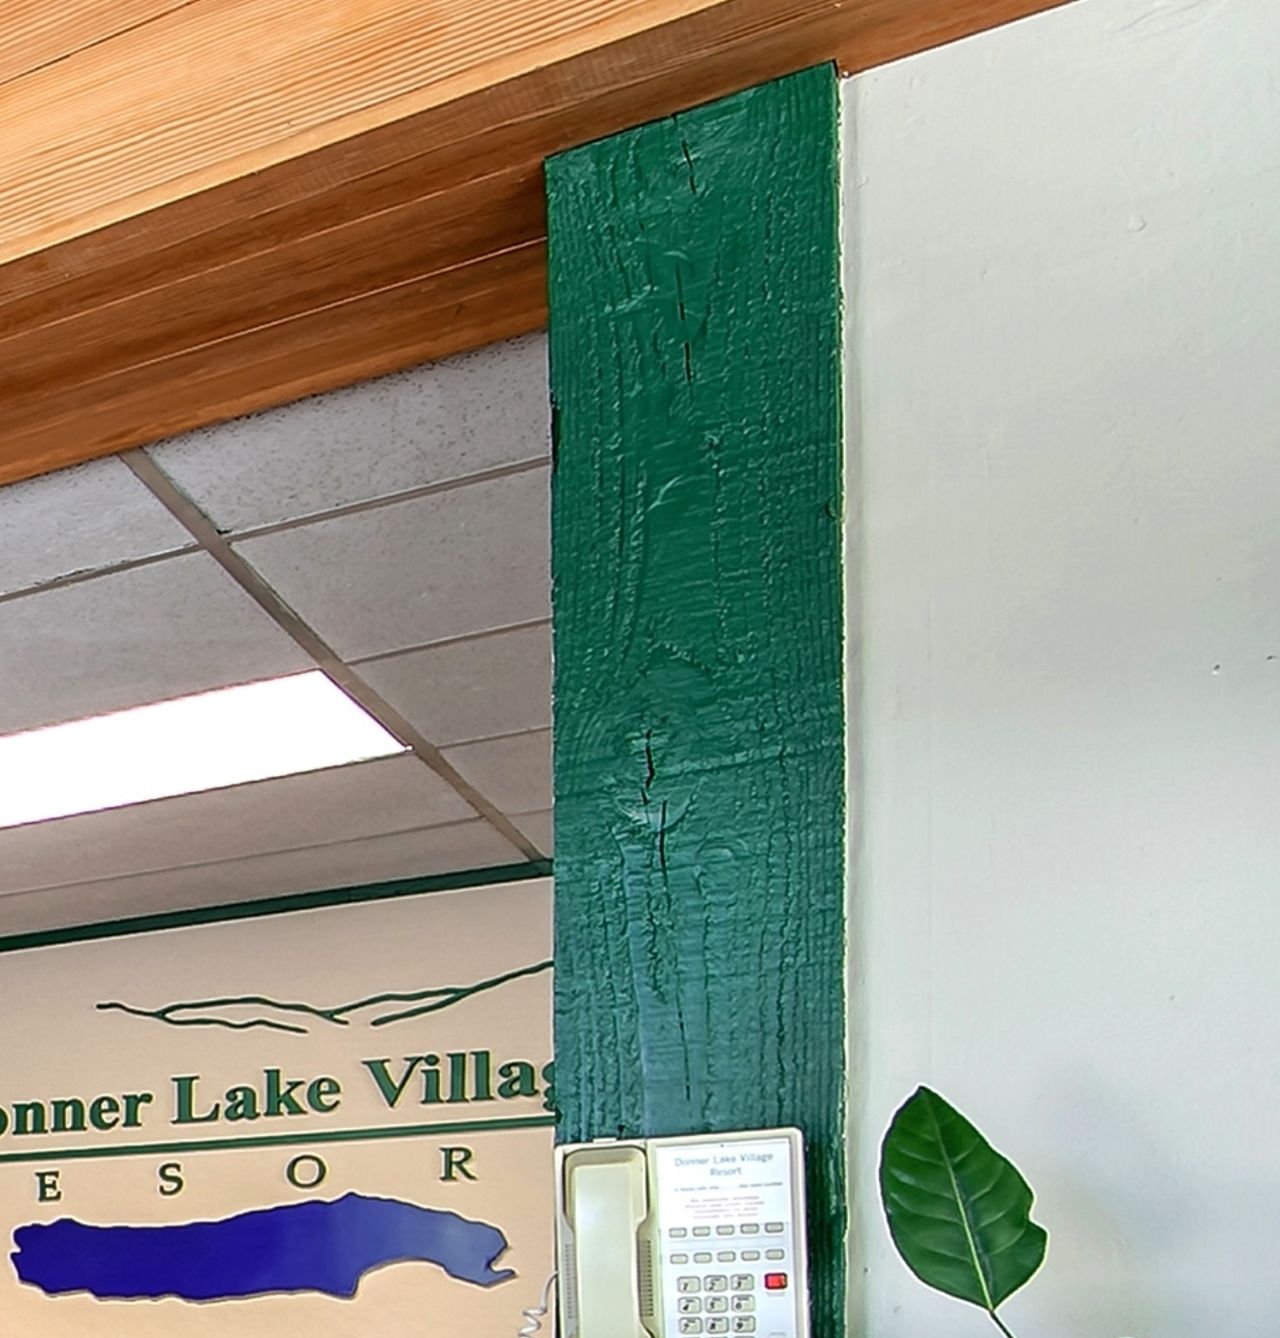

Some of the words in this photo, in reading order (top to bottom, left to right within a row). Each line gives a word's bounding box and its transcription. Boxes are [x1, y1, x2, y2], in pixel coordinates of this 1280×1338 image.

[170, 1069, 342, 1125] Lake
[713, 1155, 737, 1165] Lake
[739, 1152, 774, 1164] Village
